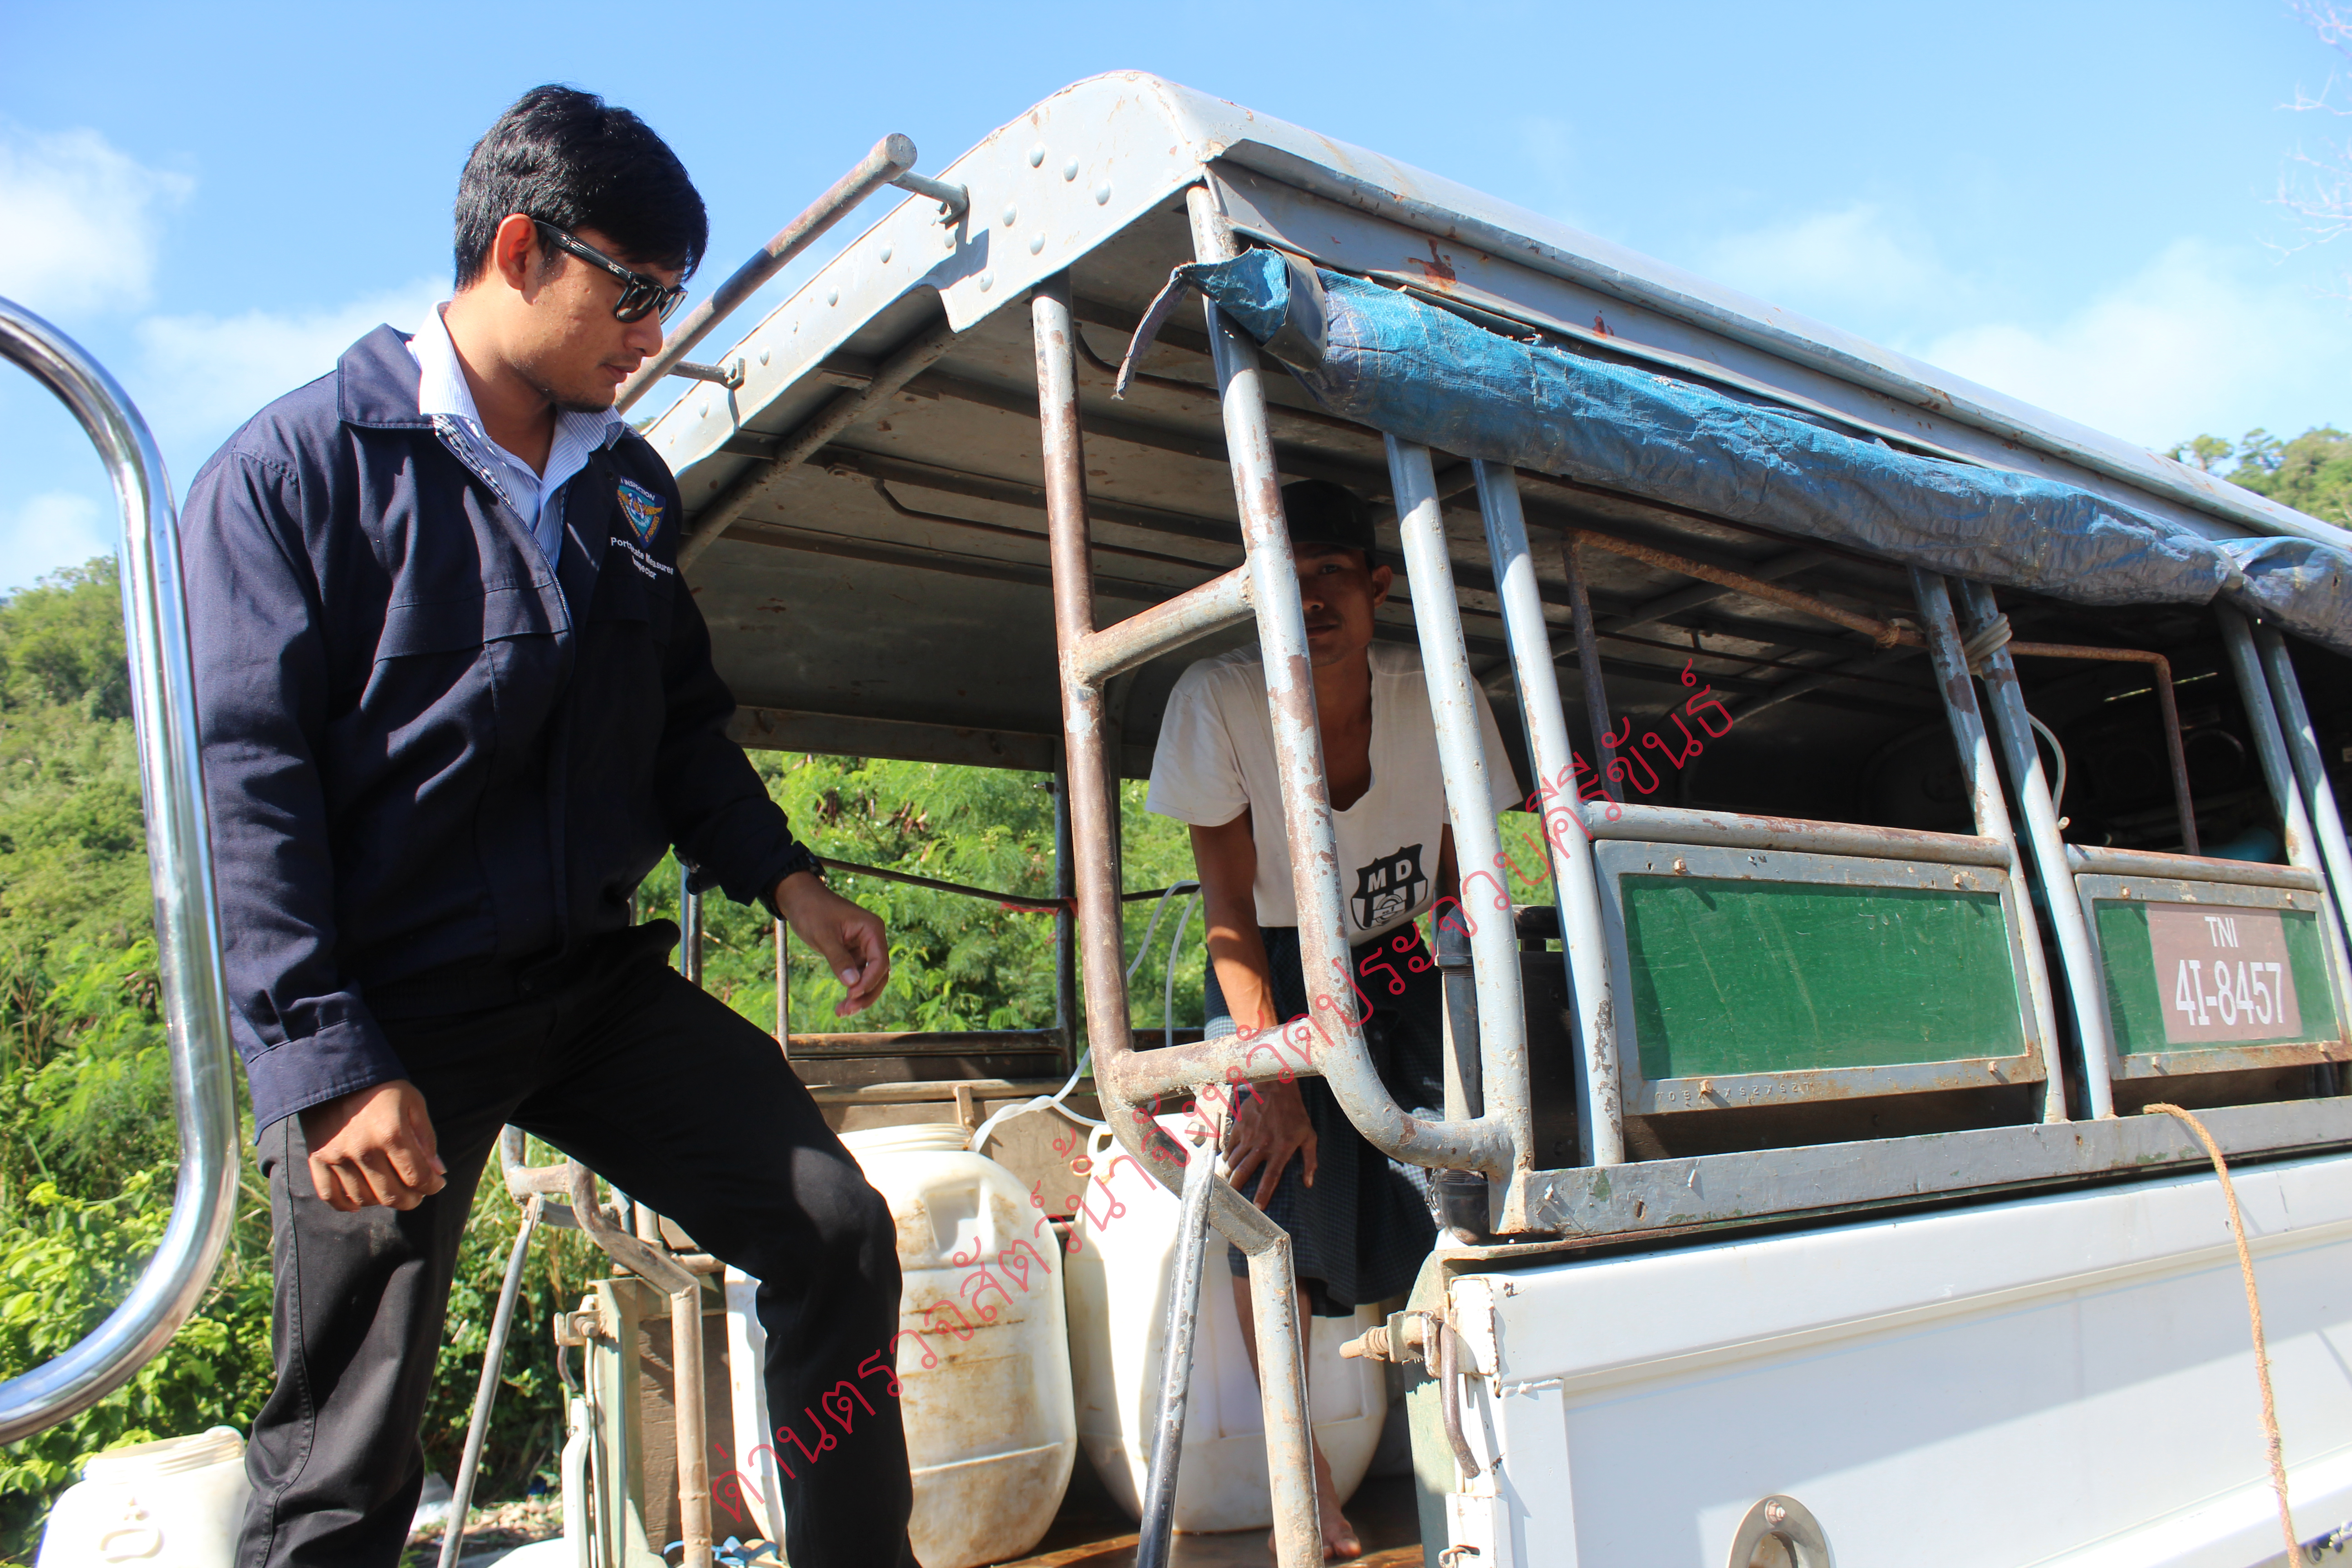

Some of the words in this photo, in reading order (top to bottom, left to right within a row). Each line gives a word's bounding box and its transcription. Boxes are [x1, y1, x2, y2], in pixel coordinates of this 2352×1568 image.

[623, 479, 655, 501] INSPECTION
[610, 537, 630, 549] Port
[646, 553, 673, 575] Measures
[2204, 916, 2239, 947] TNI
